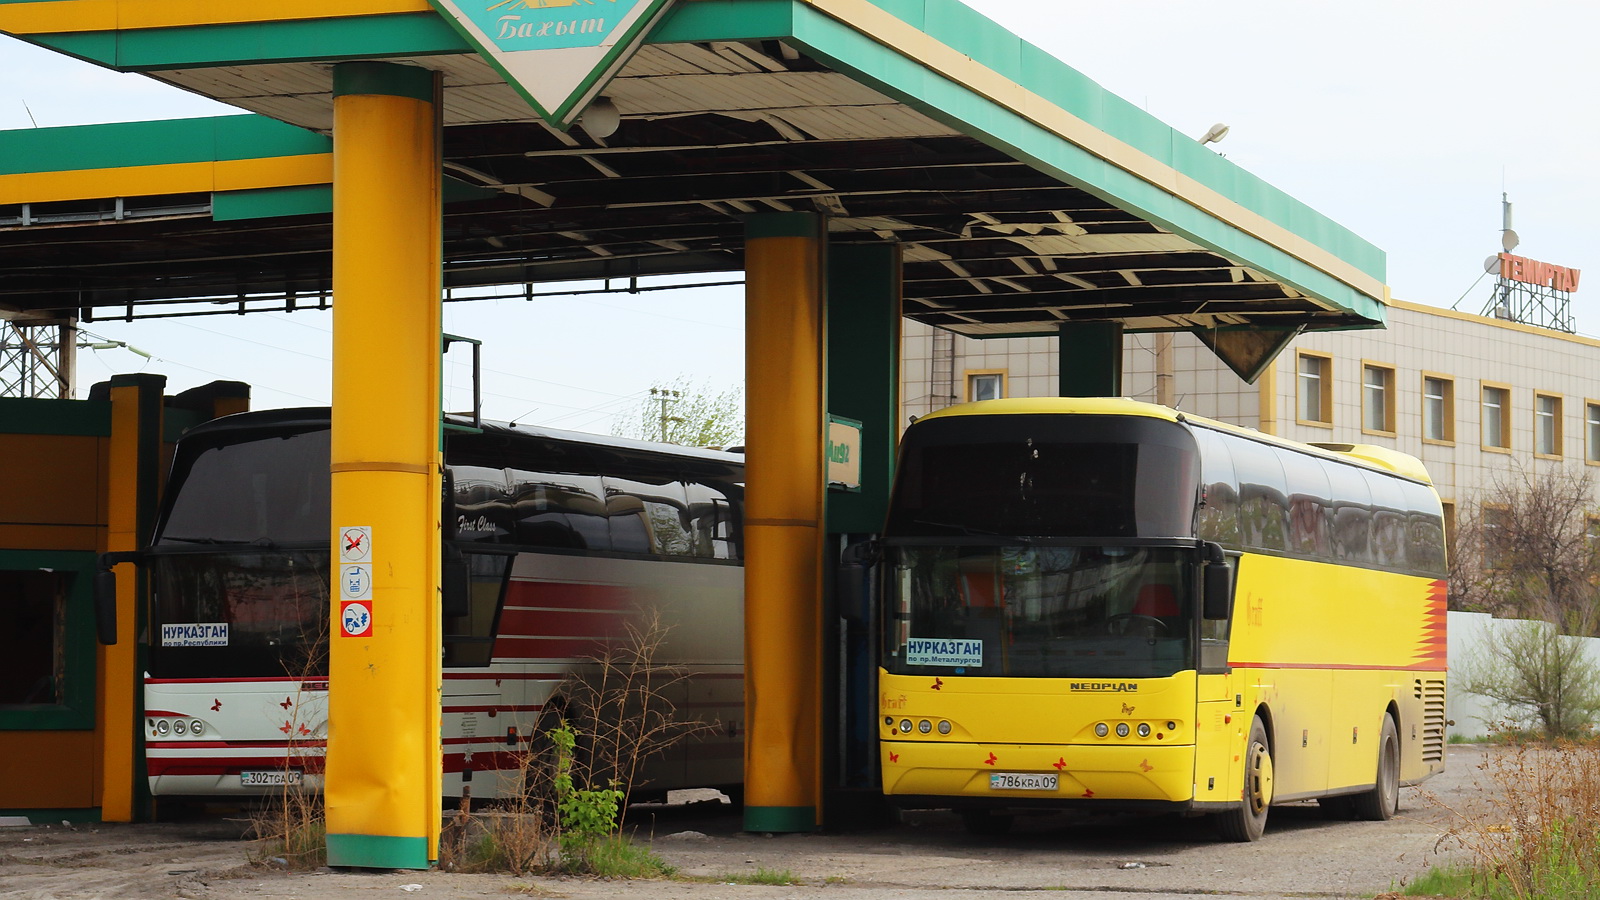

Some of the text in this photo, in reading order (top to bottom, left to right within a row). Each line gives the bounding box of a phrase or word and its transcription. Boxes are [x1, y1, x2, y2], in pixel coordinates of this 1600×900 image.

[496, 15, 605, 39] Бахыт
[1498, 252, 1580, 293] ТЕМИРТАУ
[458, 515, 496, 534] First Class
[163, 625, 227, 639] НУРКАЗГАН
[908, 641, 981, 655] НУРКАЗГАН
[1070, 683, 1138, 692] NEOPLAN
[1000, 775, 1040, 787] 786KRA
[1042, 776, 1057, 788] 09
